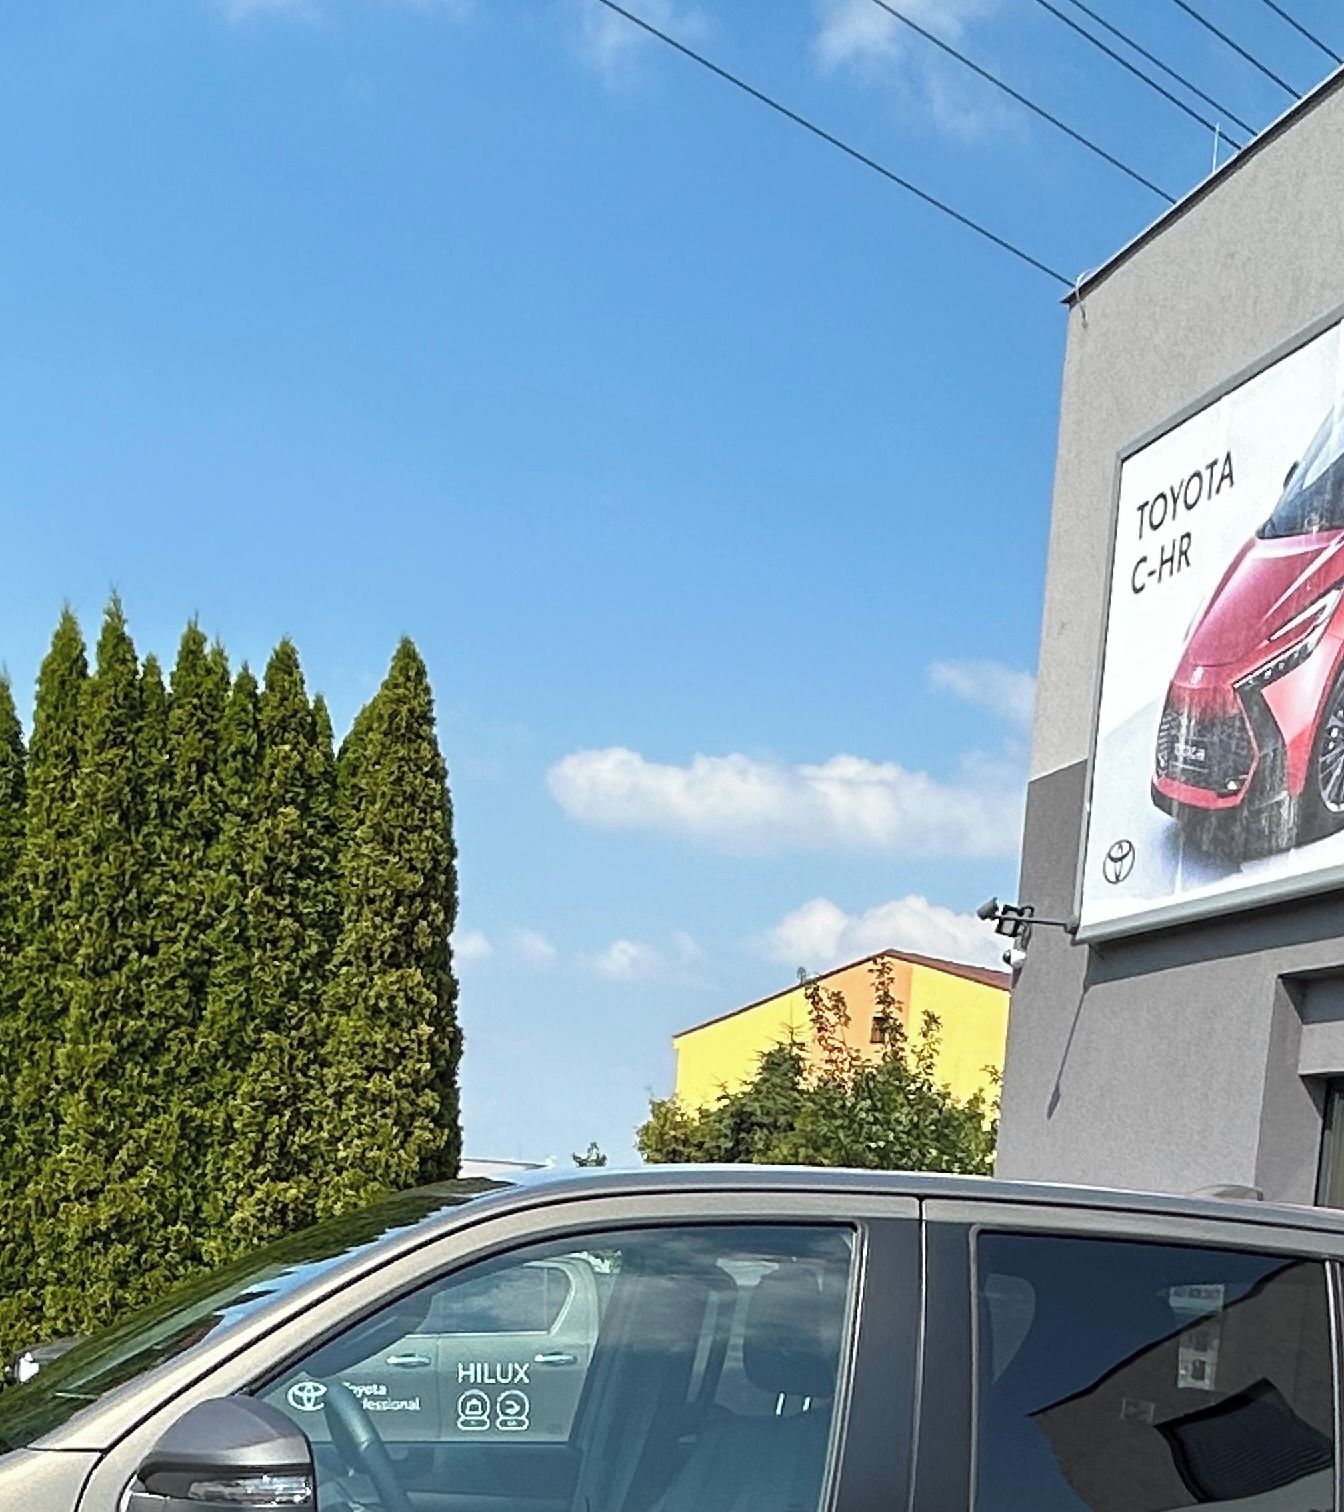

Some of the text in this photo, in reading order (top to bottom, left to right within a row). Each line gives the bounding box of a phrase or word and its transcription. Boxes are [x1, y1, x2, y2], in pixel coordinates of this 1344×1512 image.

[1136, 450, 1234, 540] TOYOTA
[1131, 531, 1192, 594] C-HR
[457, 1362, 530, 1384] HILUX
